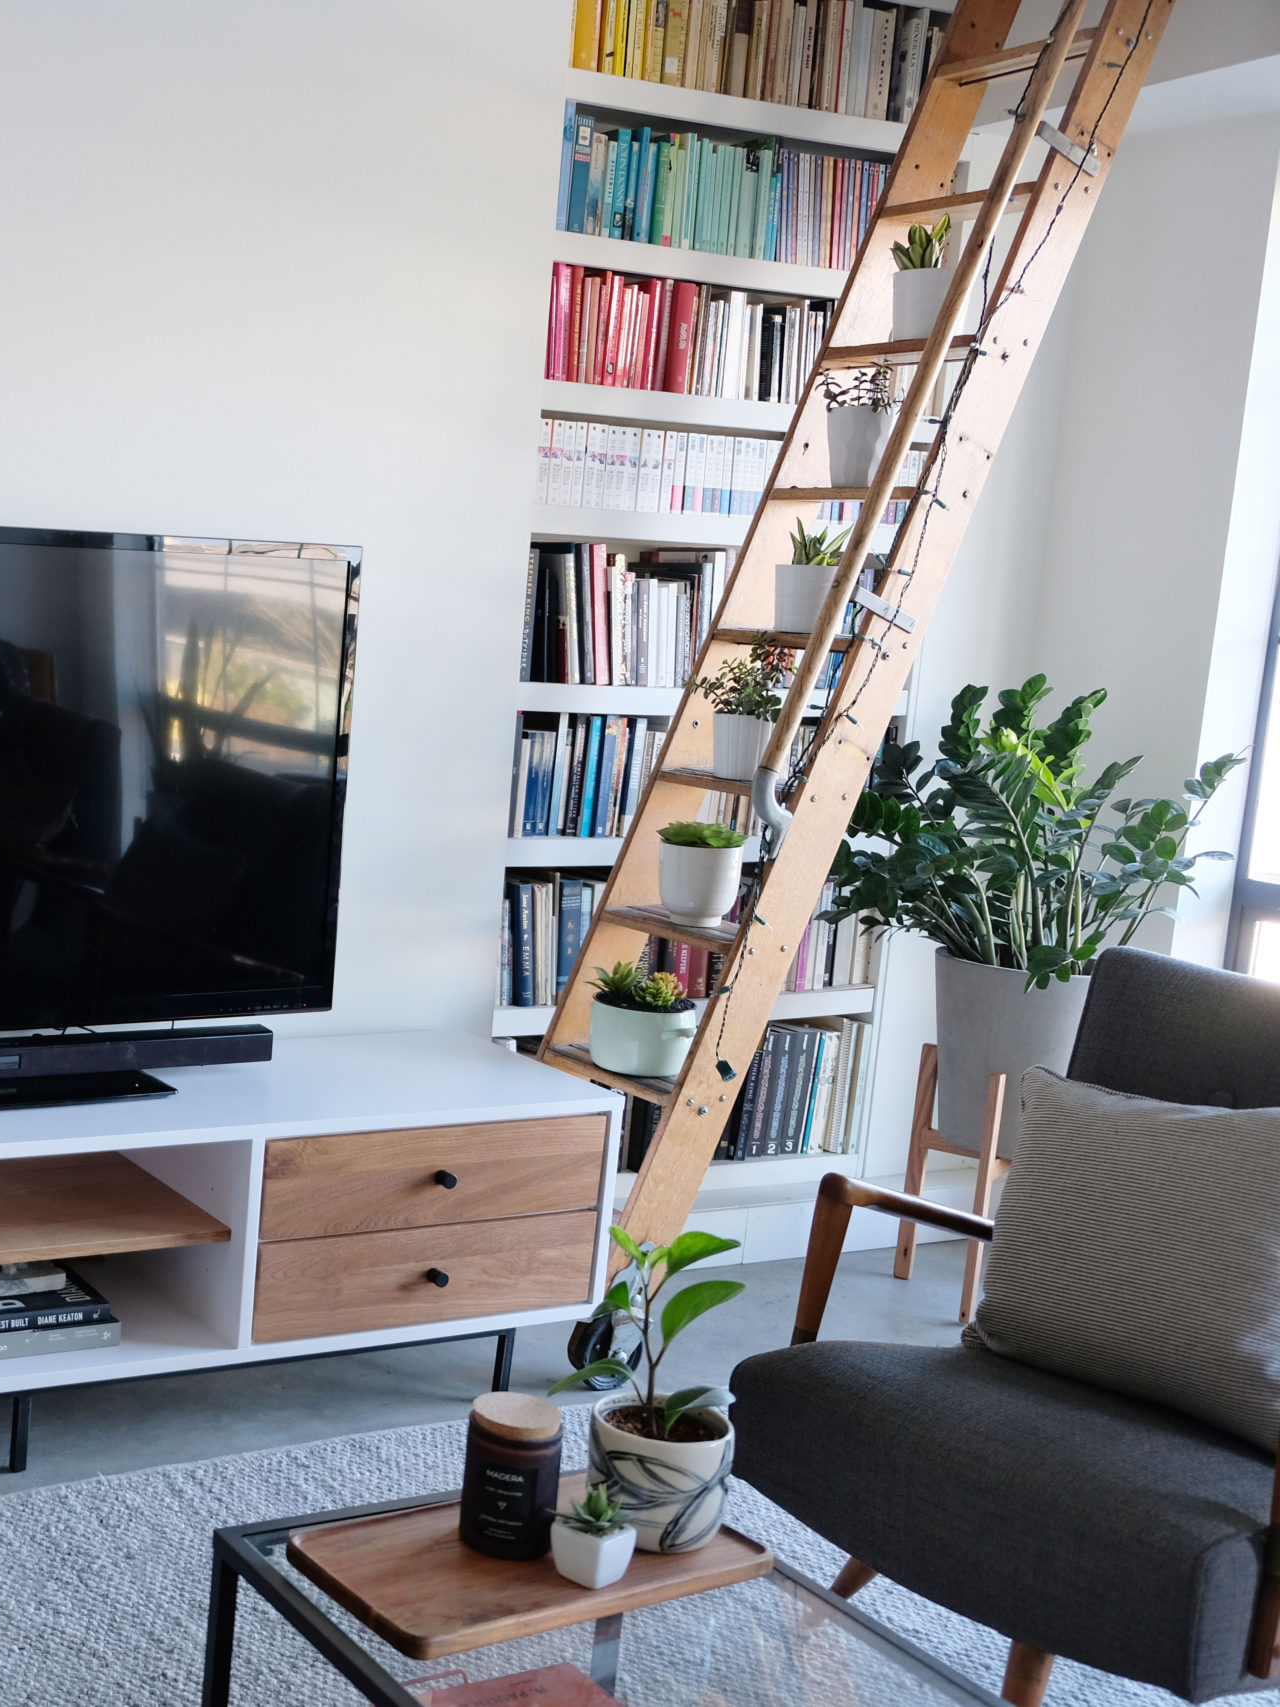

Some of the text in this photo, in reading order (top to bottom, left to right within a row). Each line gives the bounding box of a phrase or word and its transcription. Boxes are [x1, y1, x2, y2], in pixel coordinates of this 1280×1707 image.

[882, 18, 890, 55] BLACK
[910, 22, 921, 68] MINERALS
[878, 60, 886, 96] WATER
[615, 142, 629, 209] JOHN DONNE
[524, 553, 535, 622] STEPHEN KING
[522, 946, 530, 977] EMMA
[679, 949, 688, 974] KEEPERS
[747, 1053, 760, 1099] STEPHEN KING
[752, 1145, 757, 1155] 1
[767, 1143, 776, 1154] 2
[785, 1141, 793, 1152] 3
[10, 1318, 29, 1328] BUILT
[37, 1312, 83, 1325] DIANE KEATON
